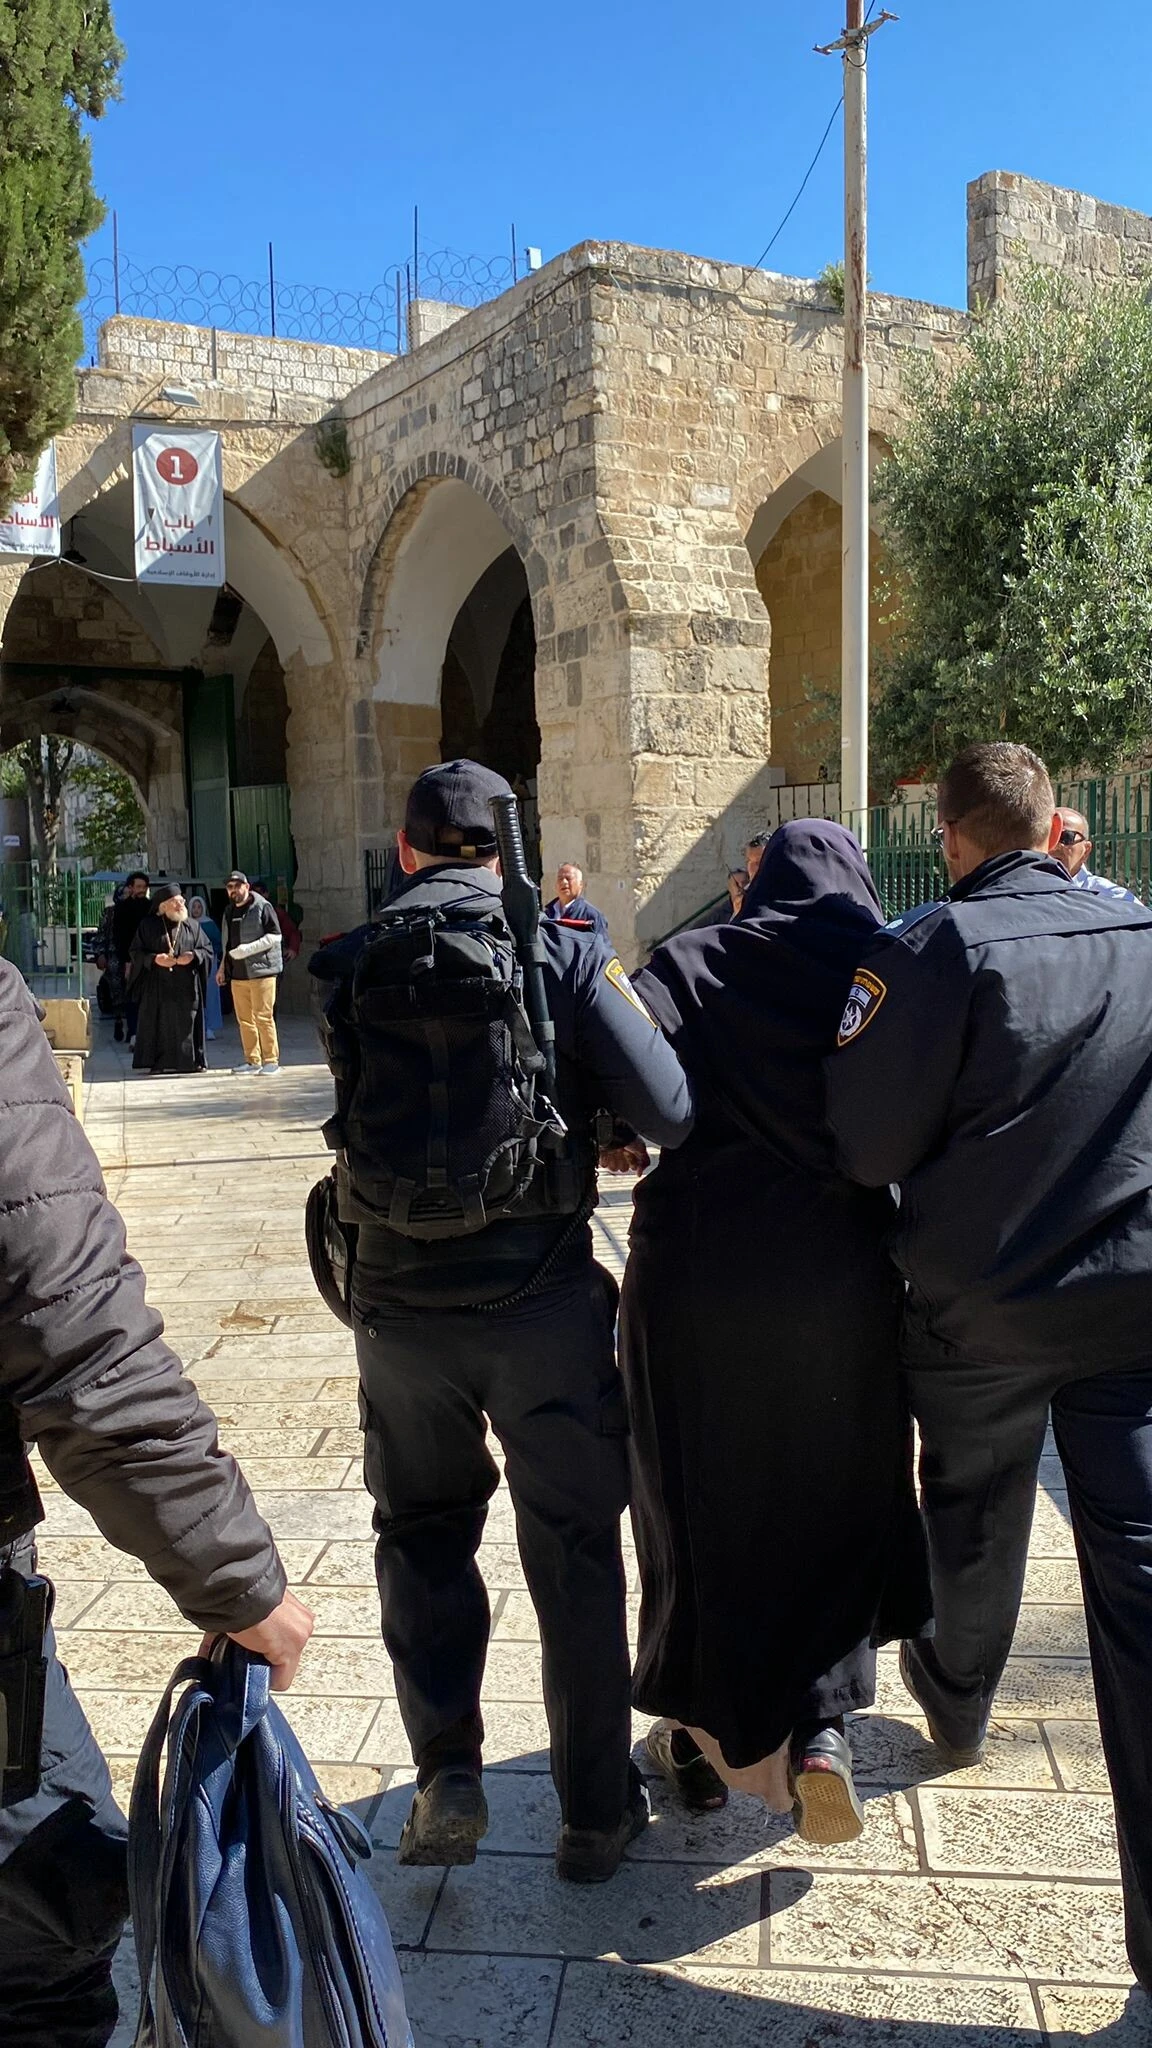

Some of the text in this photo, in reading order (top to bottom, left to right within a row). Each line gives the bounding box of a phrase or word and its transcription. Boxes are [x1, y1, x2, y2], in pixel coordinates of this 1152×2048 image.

[170, 455, 184, 479] 1
[164, 514, 195, 534] باب
[145, 536, 214, 556] الأسباط
